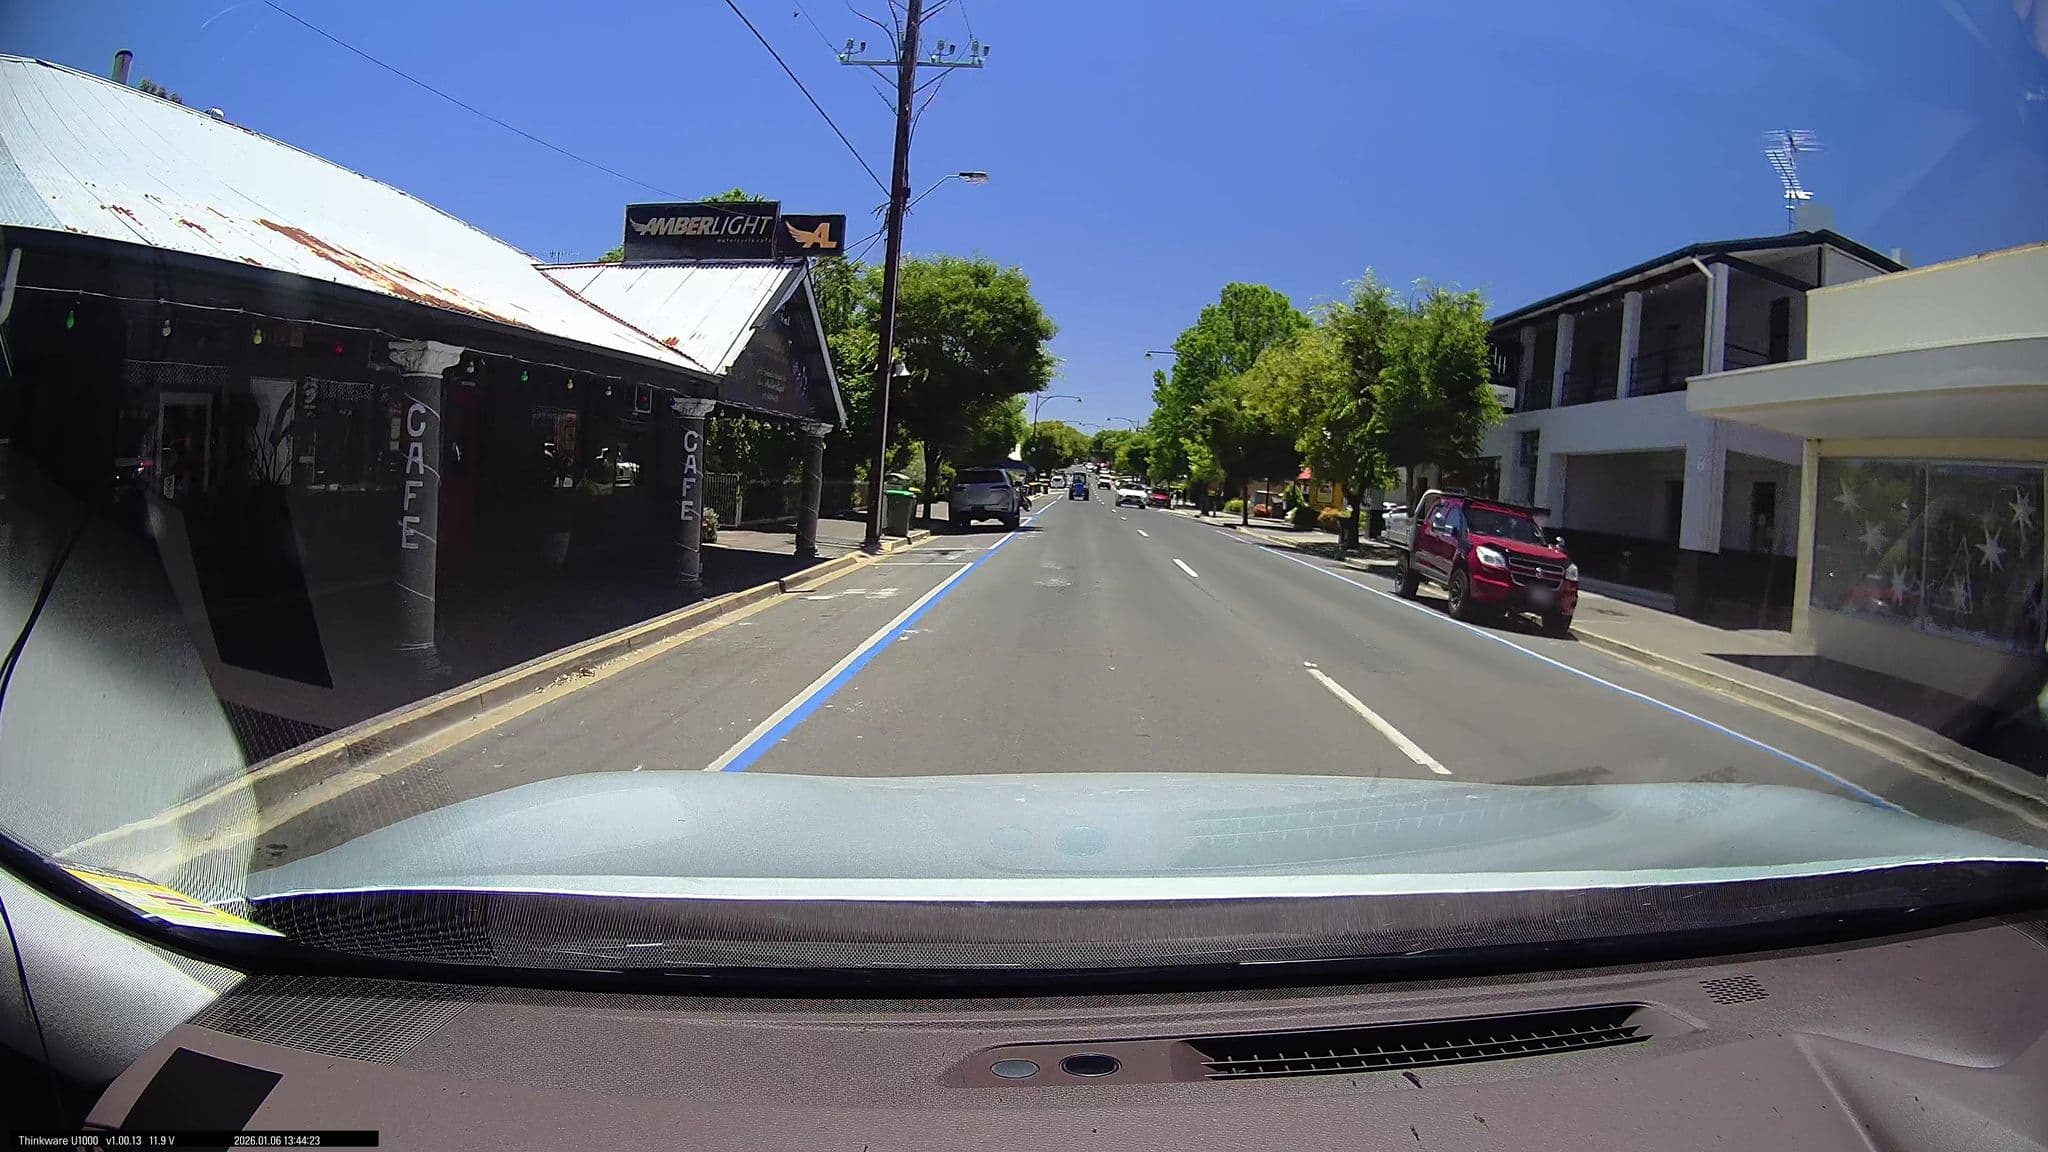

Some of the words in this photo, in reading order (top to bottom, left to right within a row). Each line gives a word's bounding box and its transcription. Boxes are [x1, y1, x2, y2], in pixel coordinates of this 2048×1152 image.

[639, 216, 773, 236] AMBERLIGHT
[401, 402, 427, 550] CAFE
[680, 430, 698, 521] CAFE
